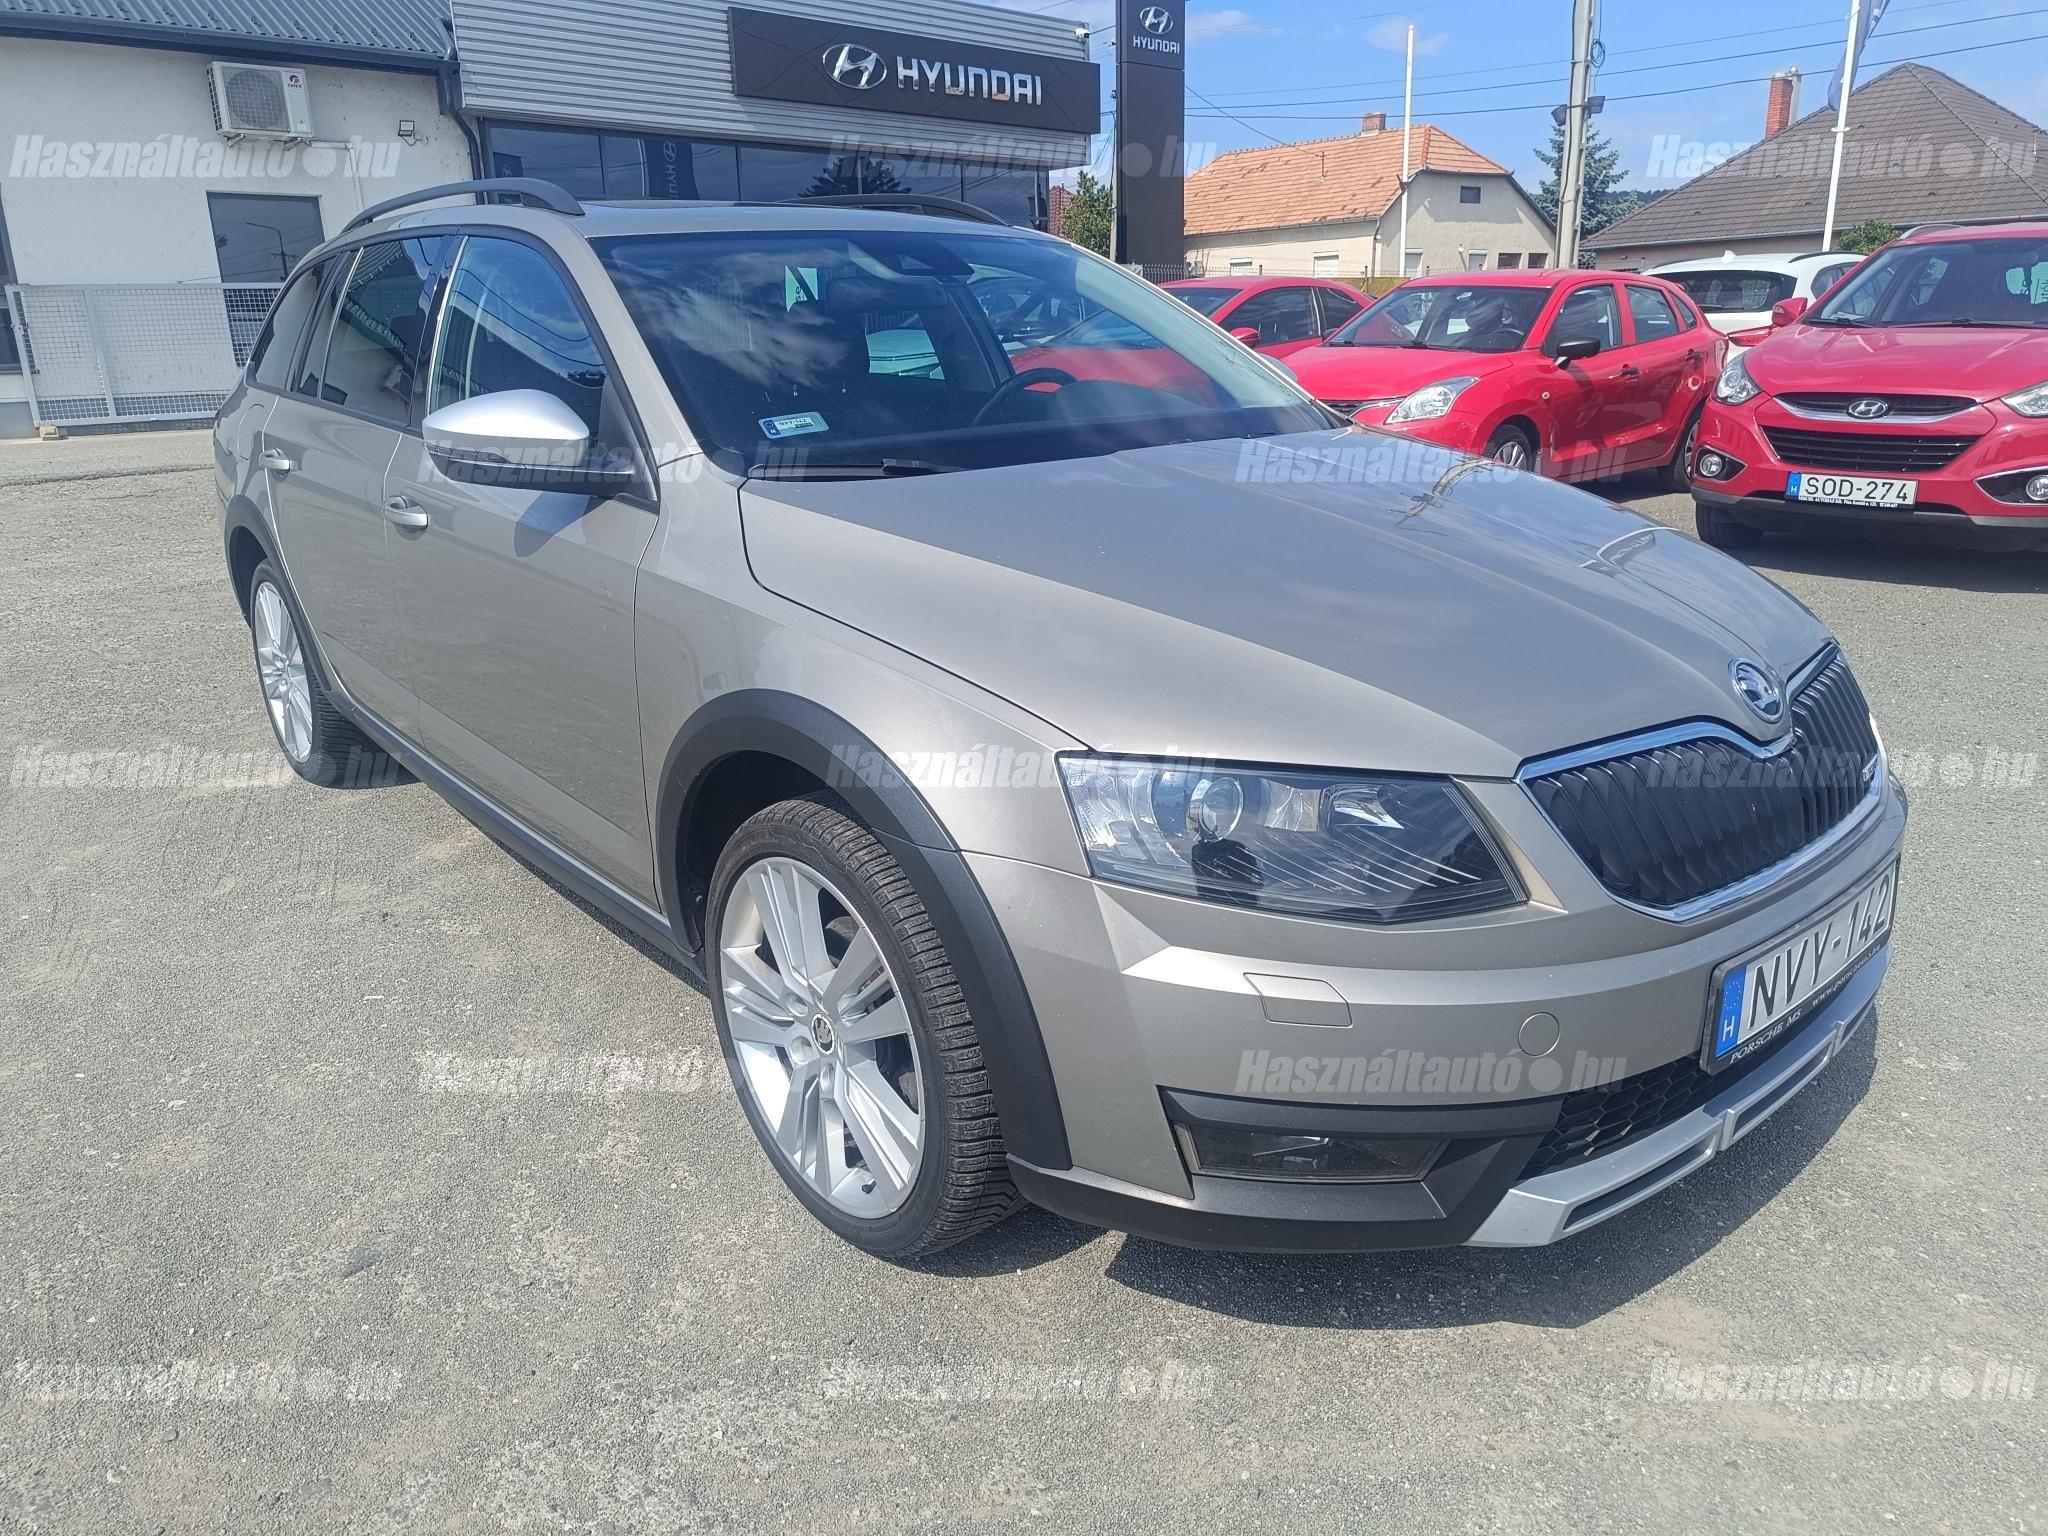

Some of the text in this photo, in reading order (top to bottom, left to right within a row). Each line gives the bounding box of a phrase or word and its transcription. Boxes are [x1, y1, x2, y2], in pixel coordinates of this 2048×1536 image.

[1132, 35, 1180, 55] HYUNDAI
[896, 56, 1042, 105] HYUNDAI
[1790, 485, 1797, 493] H
[1805, 477, 1908, 501] SOD-274
[1747, 874, 1890, 1030] NVY-142
[1722, 1015, 1735, 1042] H
[1729, 1021, 1783, 1064] PORSCHE
